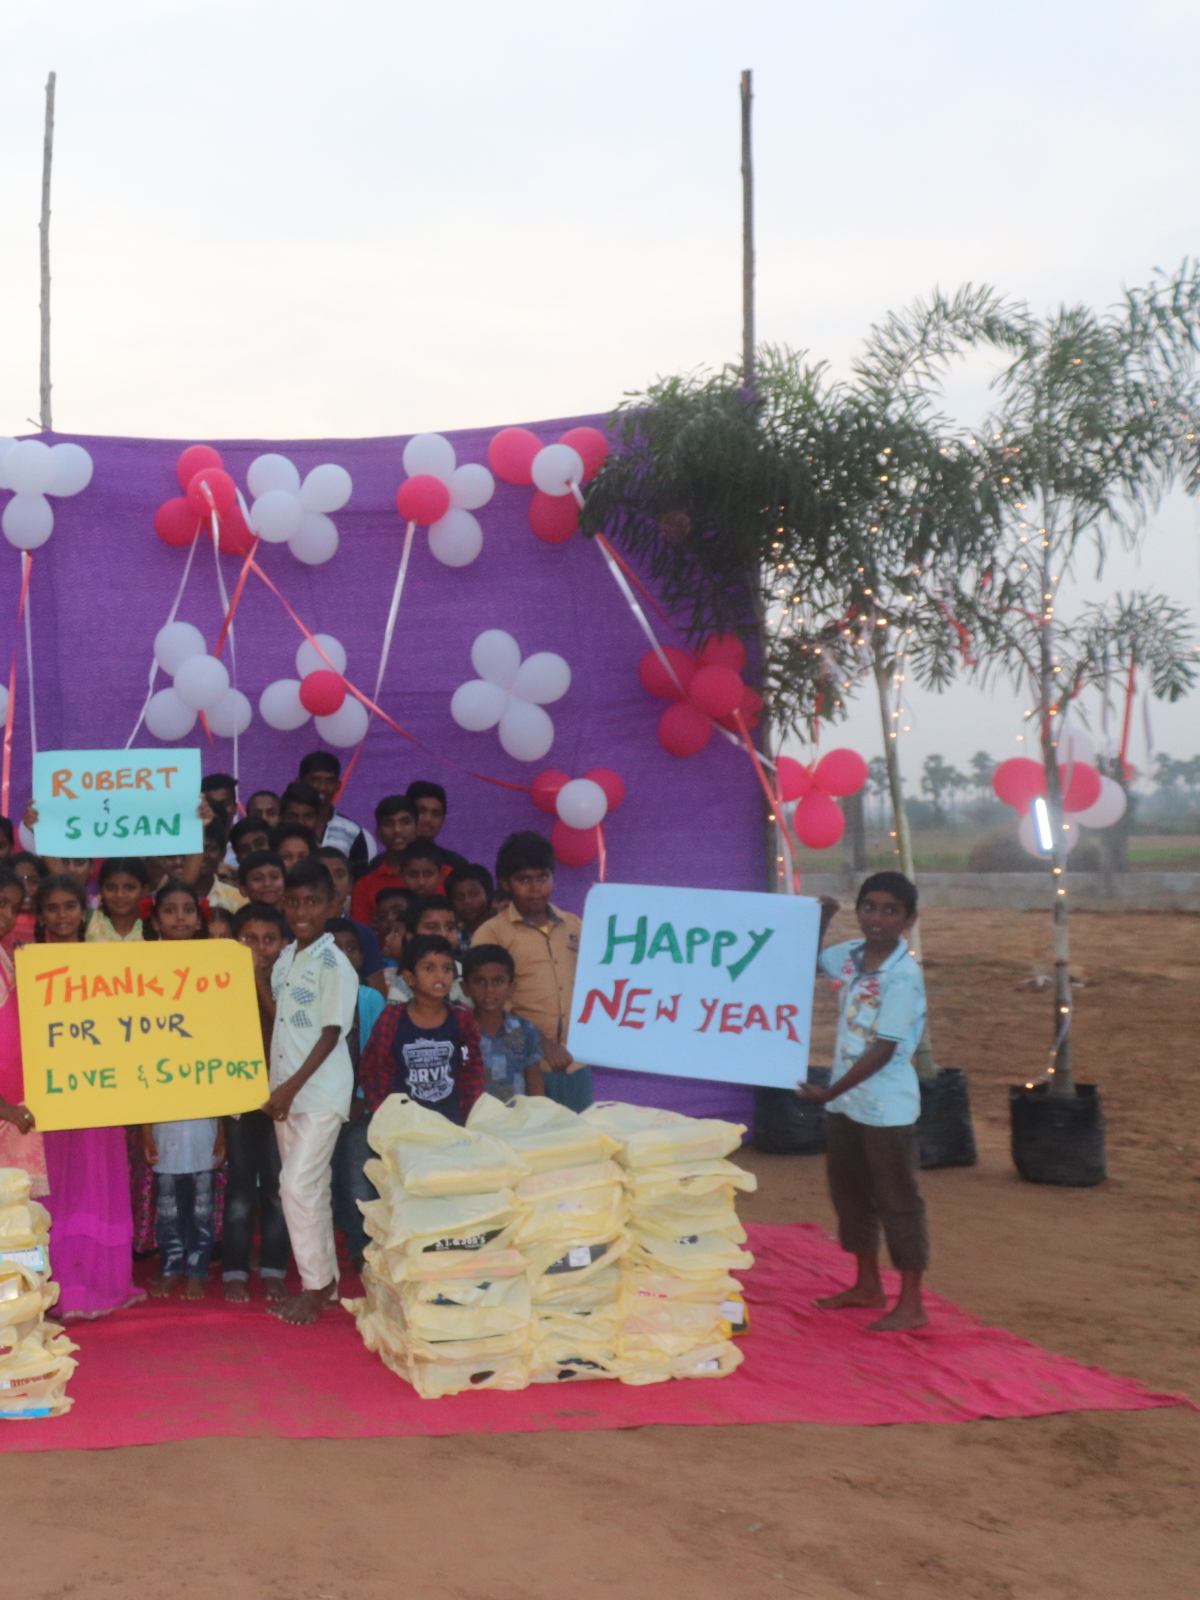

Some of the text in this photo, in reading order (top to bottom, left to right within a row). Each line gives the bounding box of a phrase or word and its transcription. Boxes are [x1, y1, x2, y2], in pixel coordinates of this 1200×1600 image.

[51, 767, 178, 799] ROBERT
[64, 813, 181, 840] SUSAN
[599, 914, 776, 982] HAPPY
[34, 966, 231, 1006] THANK YOU
[48, 1013, 194, 1048] FOR YOUR
[577, 979, 803, 1045] NEW YEAR
[46, 1067, 117, 1094] LOVE
[156, 1057, 264, 1085] SUPPORT
